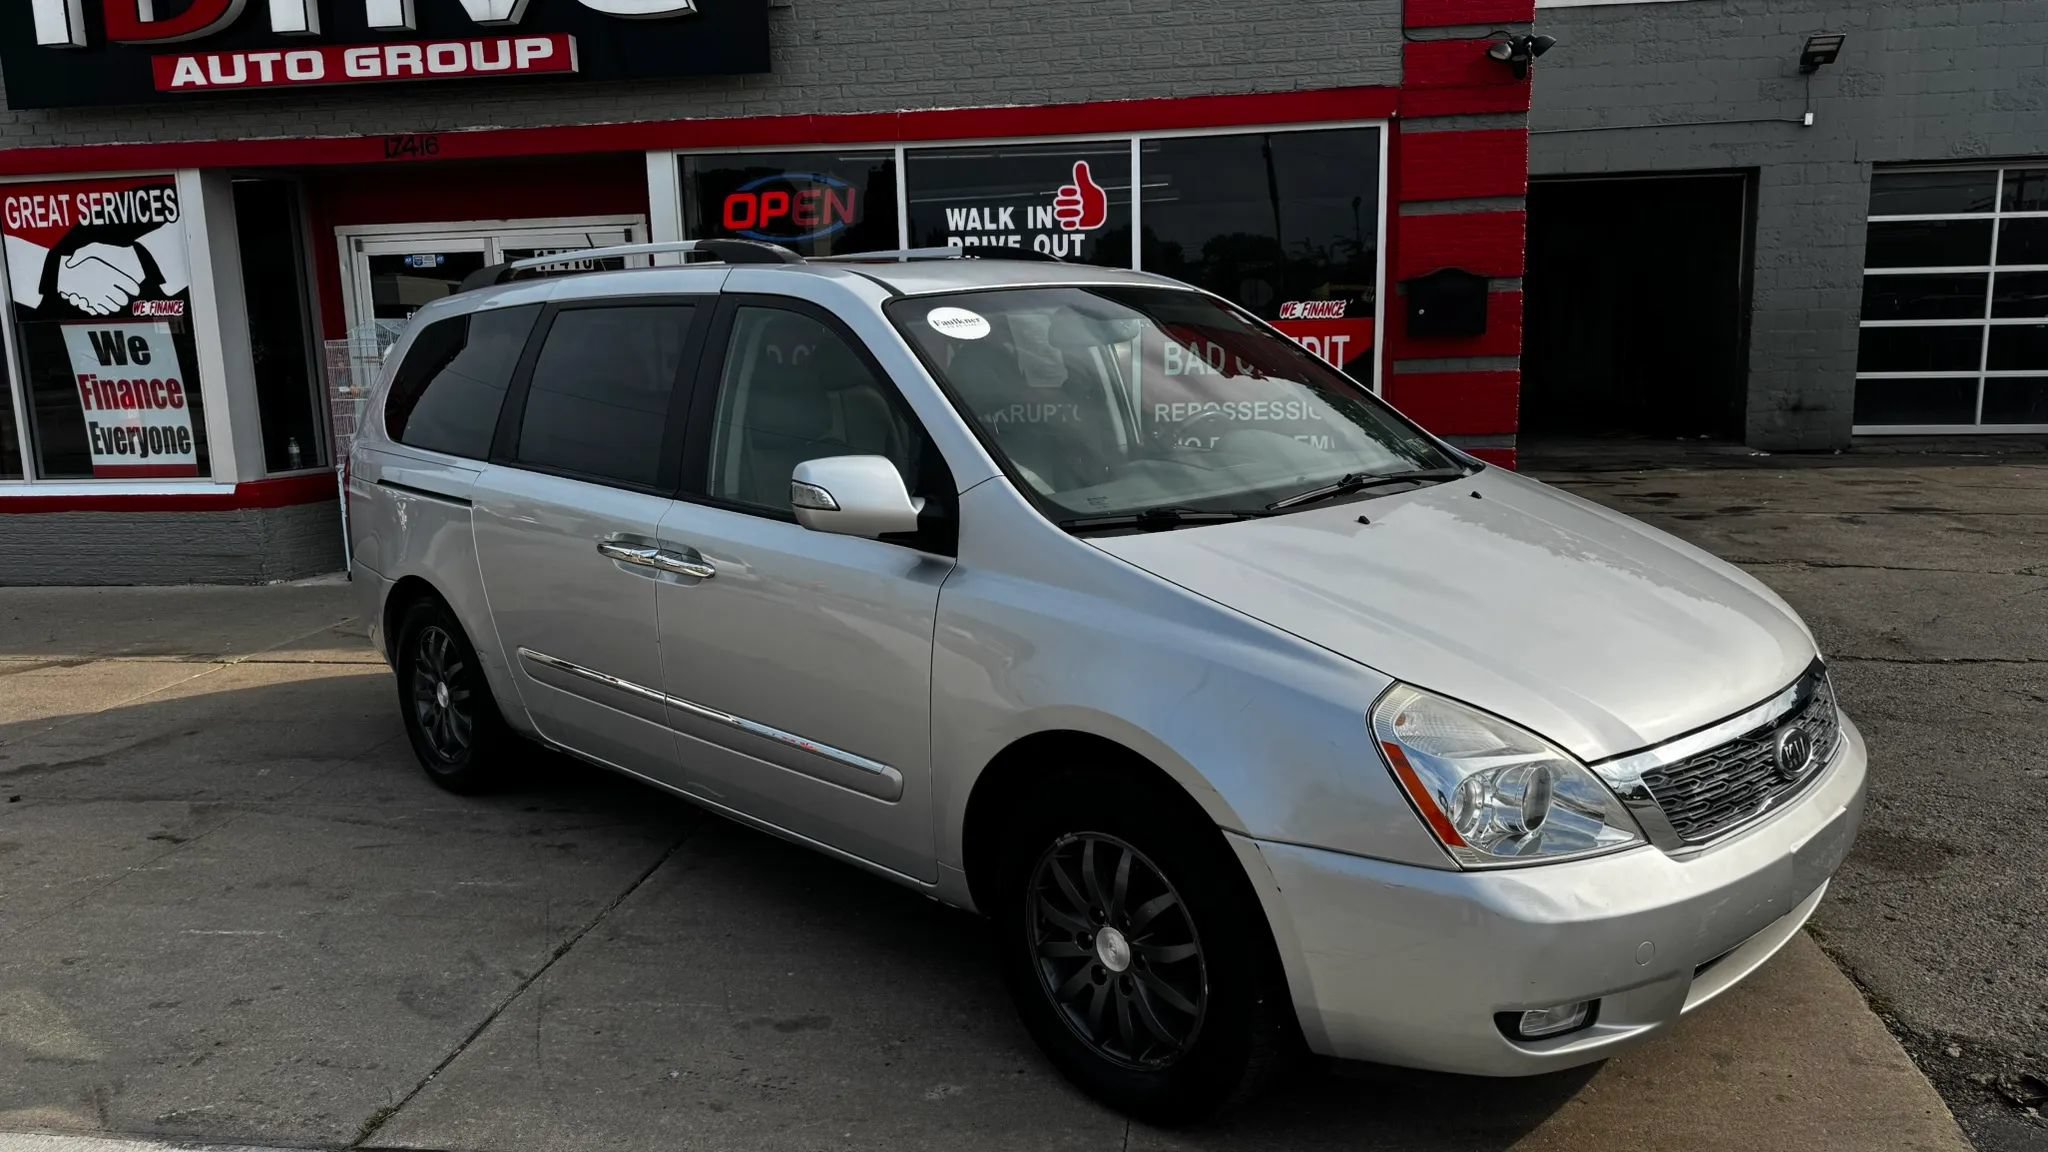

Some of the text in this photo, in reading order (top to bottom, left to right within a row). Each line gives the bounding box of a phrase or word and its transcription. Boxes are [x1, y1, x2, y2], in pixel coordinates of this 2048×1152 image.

[170, 37, 555, 87] AUTO GROUP
[4, 187, 180, 229] GREAT SERVICES
[722, 187, 857, 231] OPEN
[945, 205, 1053, 231] WALK IN
[1034, 233, 1086, 258] OUT
[132, 299, 185, 317] WE FINANCE
[932, 317, 981, 327] Faulkner
[1280, 299, 1346, 319] WE FINANCE
[87, 330, 152, 367] We
[1164, 340, 1225, 376] BAD
[76, 373, 184, 411] Finance
[89, 423, 192, 458] Everyone
